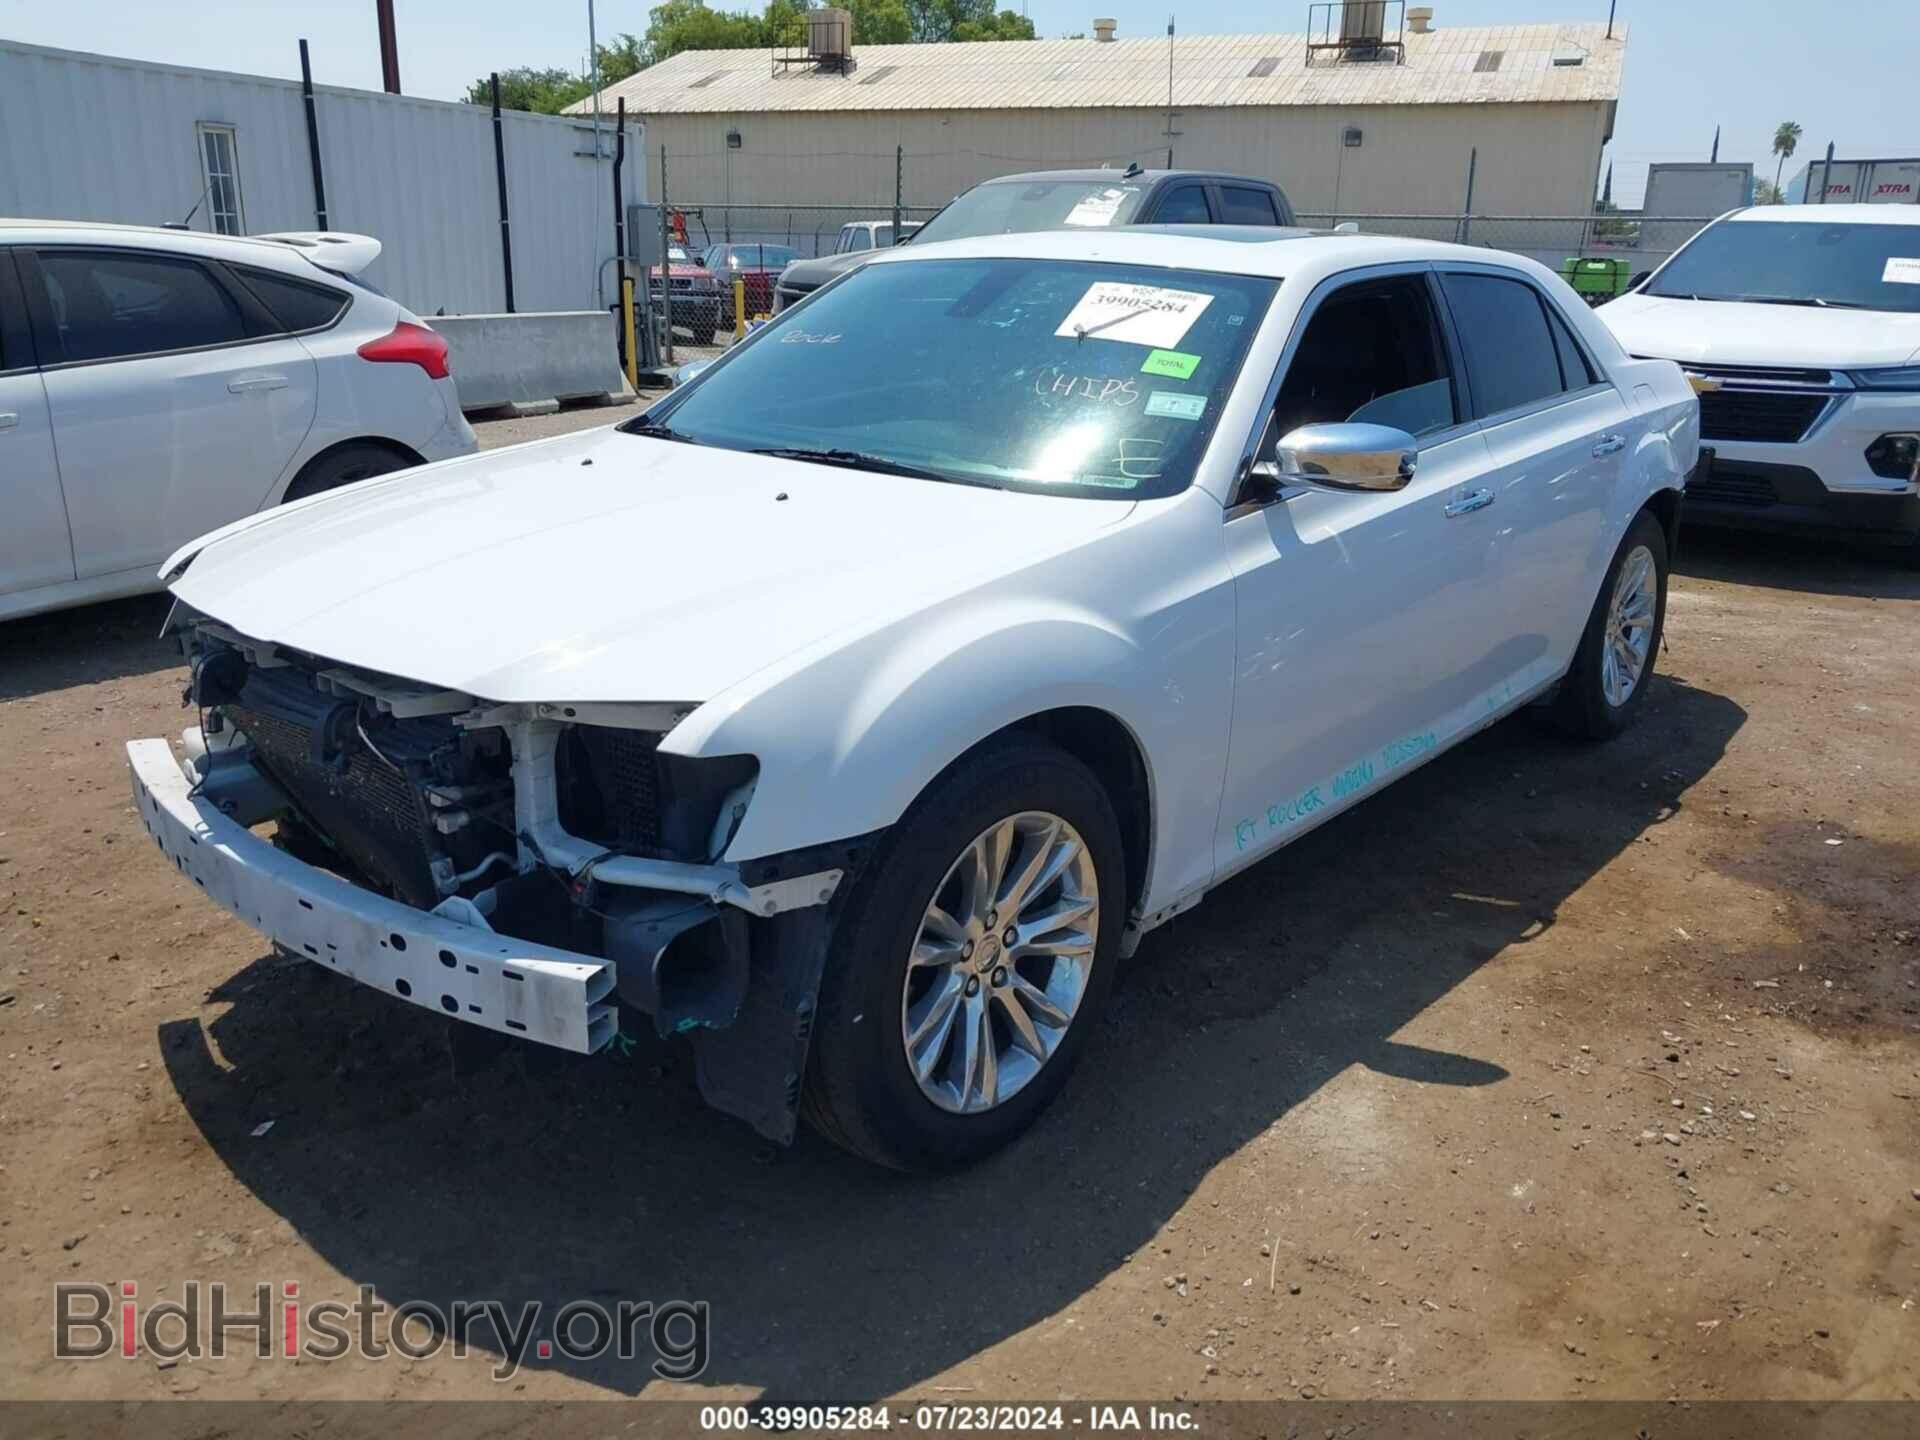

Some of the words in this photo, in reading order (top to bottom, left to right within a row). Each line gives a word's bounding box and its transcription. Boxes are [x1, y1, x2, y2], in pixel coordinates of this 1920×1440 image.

[1816, 184, 1851, 196] TRA
[1872, 183, 1911, 196] XTRA
[1091, 294, 1188, 314] 39905284
[1035, 369, 1140, 407] CHIPS
